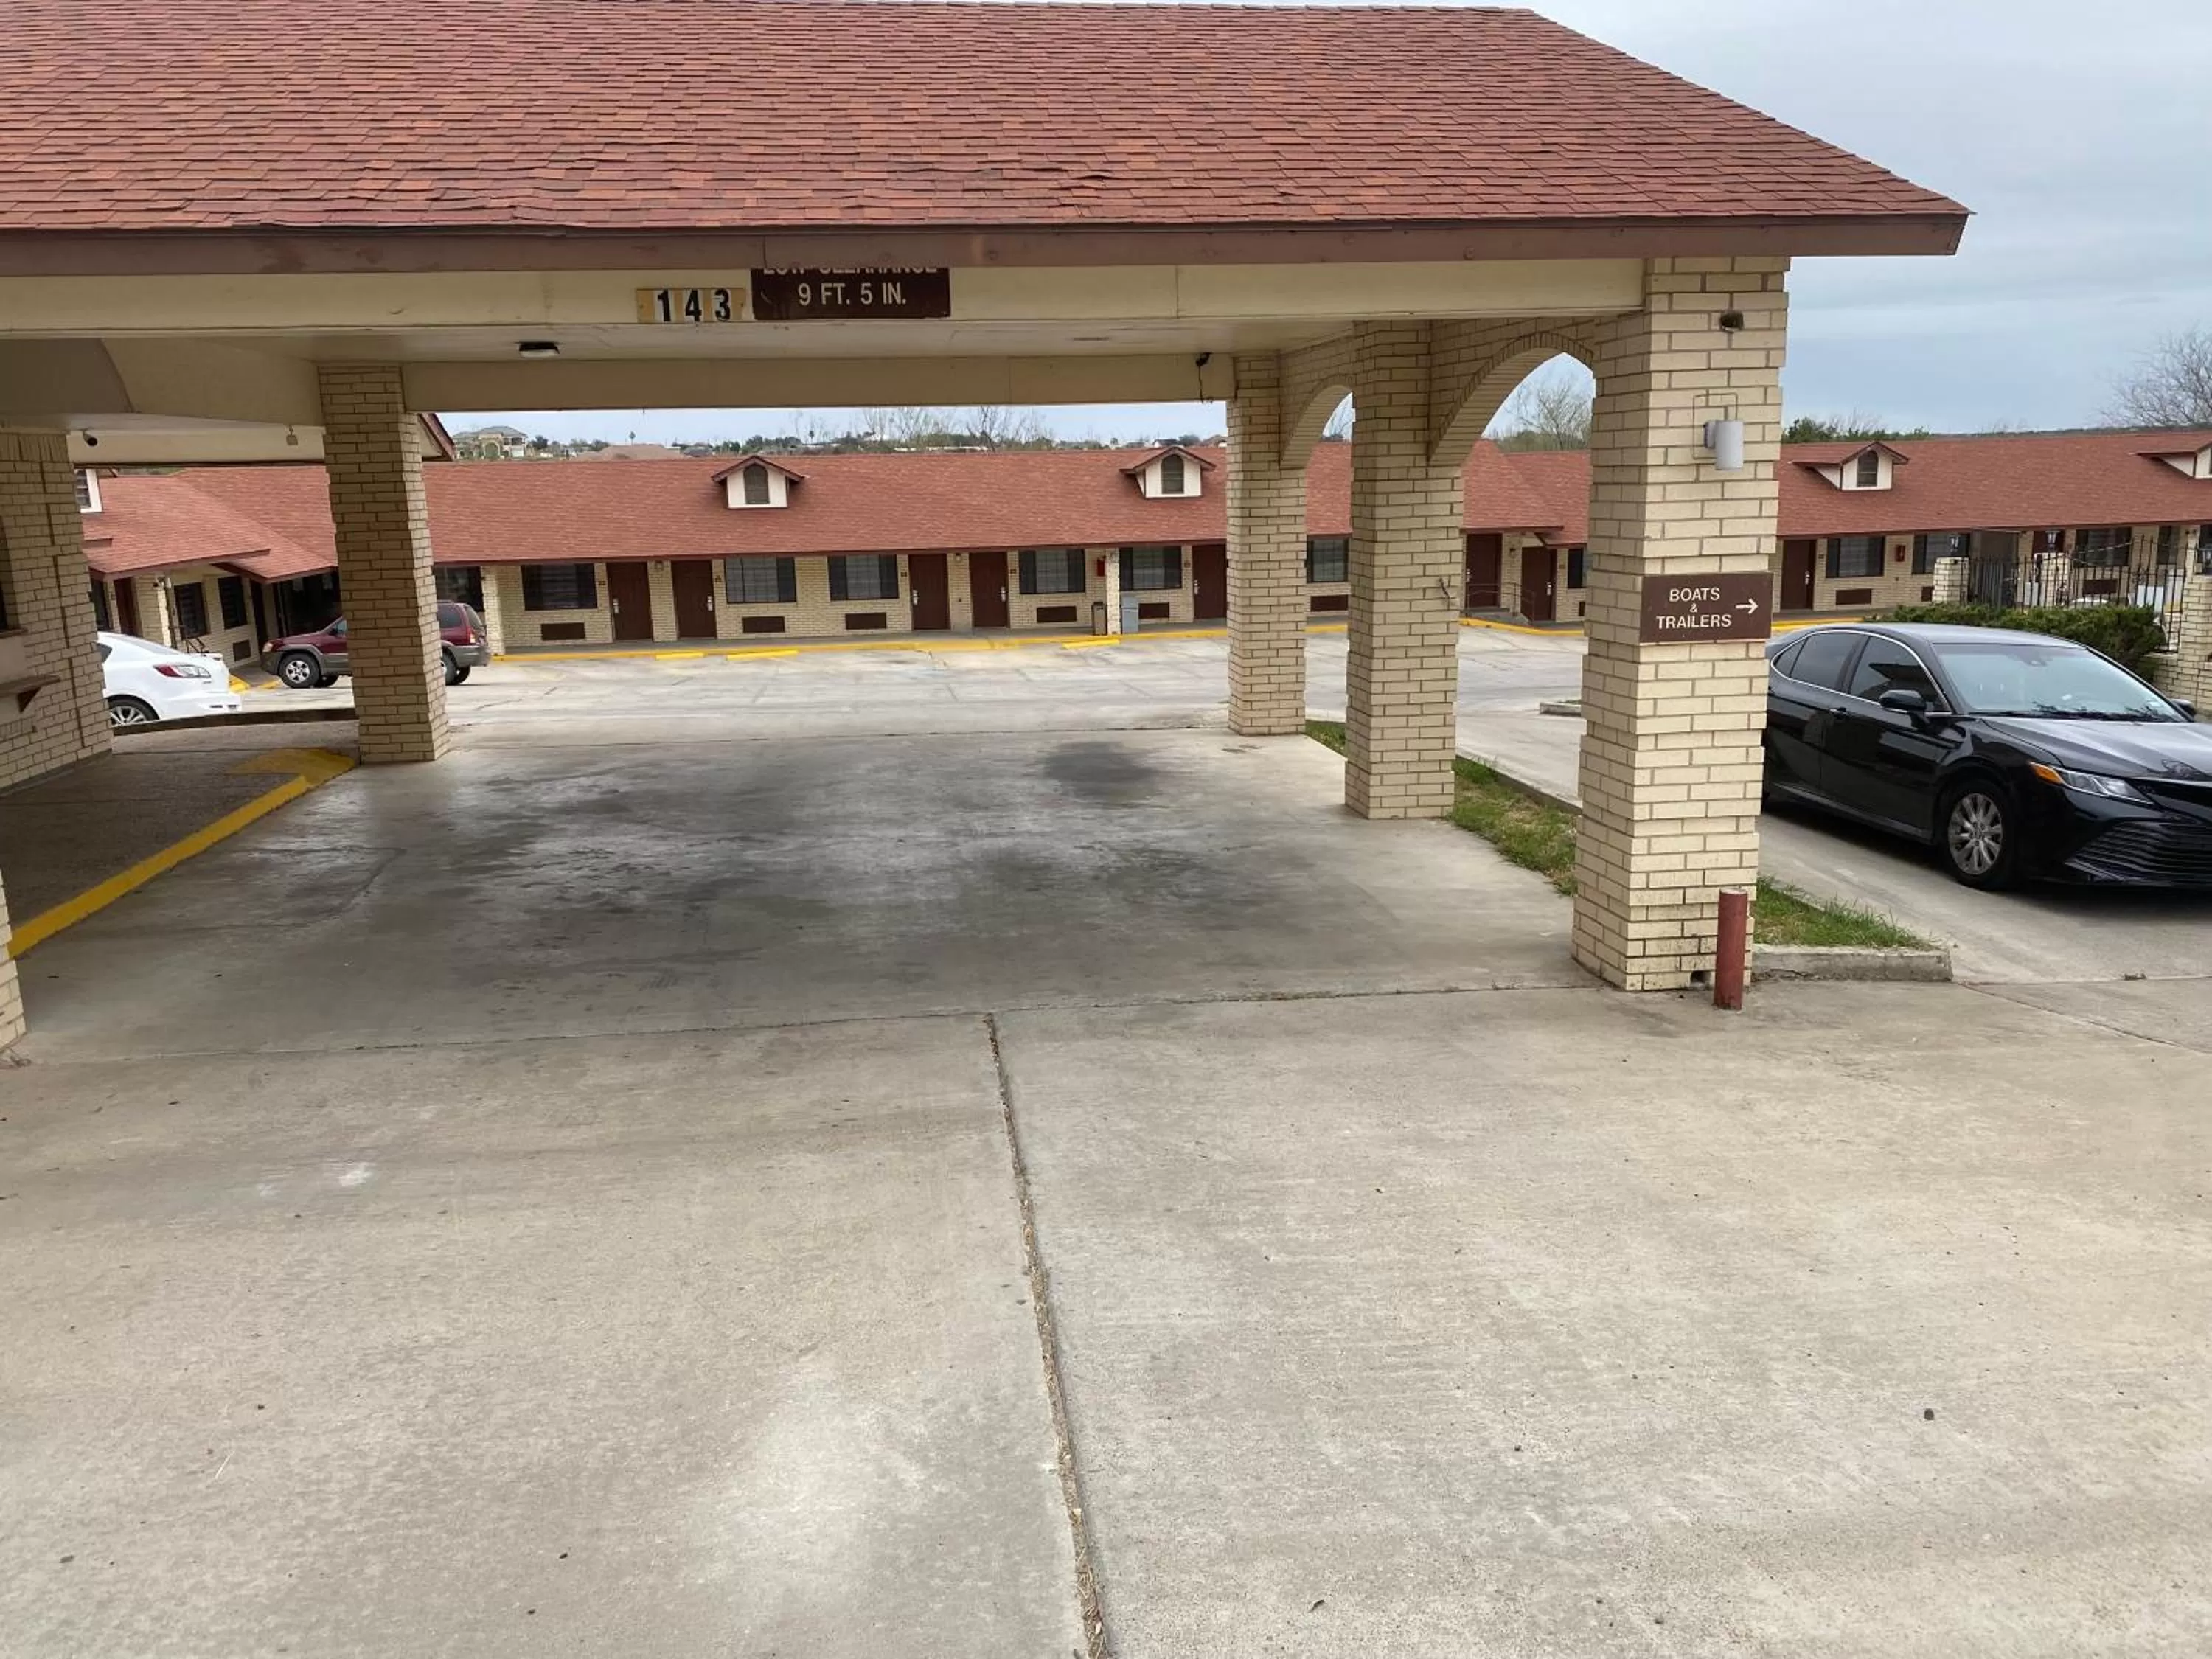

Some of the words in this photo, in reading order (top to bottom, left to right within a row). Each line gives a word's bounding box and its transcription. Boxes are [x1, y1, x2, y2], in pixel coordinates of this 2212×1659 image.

[799, 282, 810, 305] 9
[821, 282, 850, 305] FT.
[860, 282, 872, 305] 5
[882, 282, 906, 305] IN.
[658, 288, 731, 322] 143
[1669, 587, 1720, 602] BOATS
[1689, 602, 1698, 613] &
[1656, 614, 1732, 629] TRAILERS
